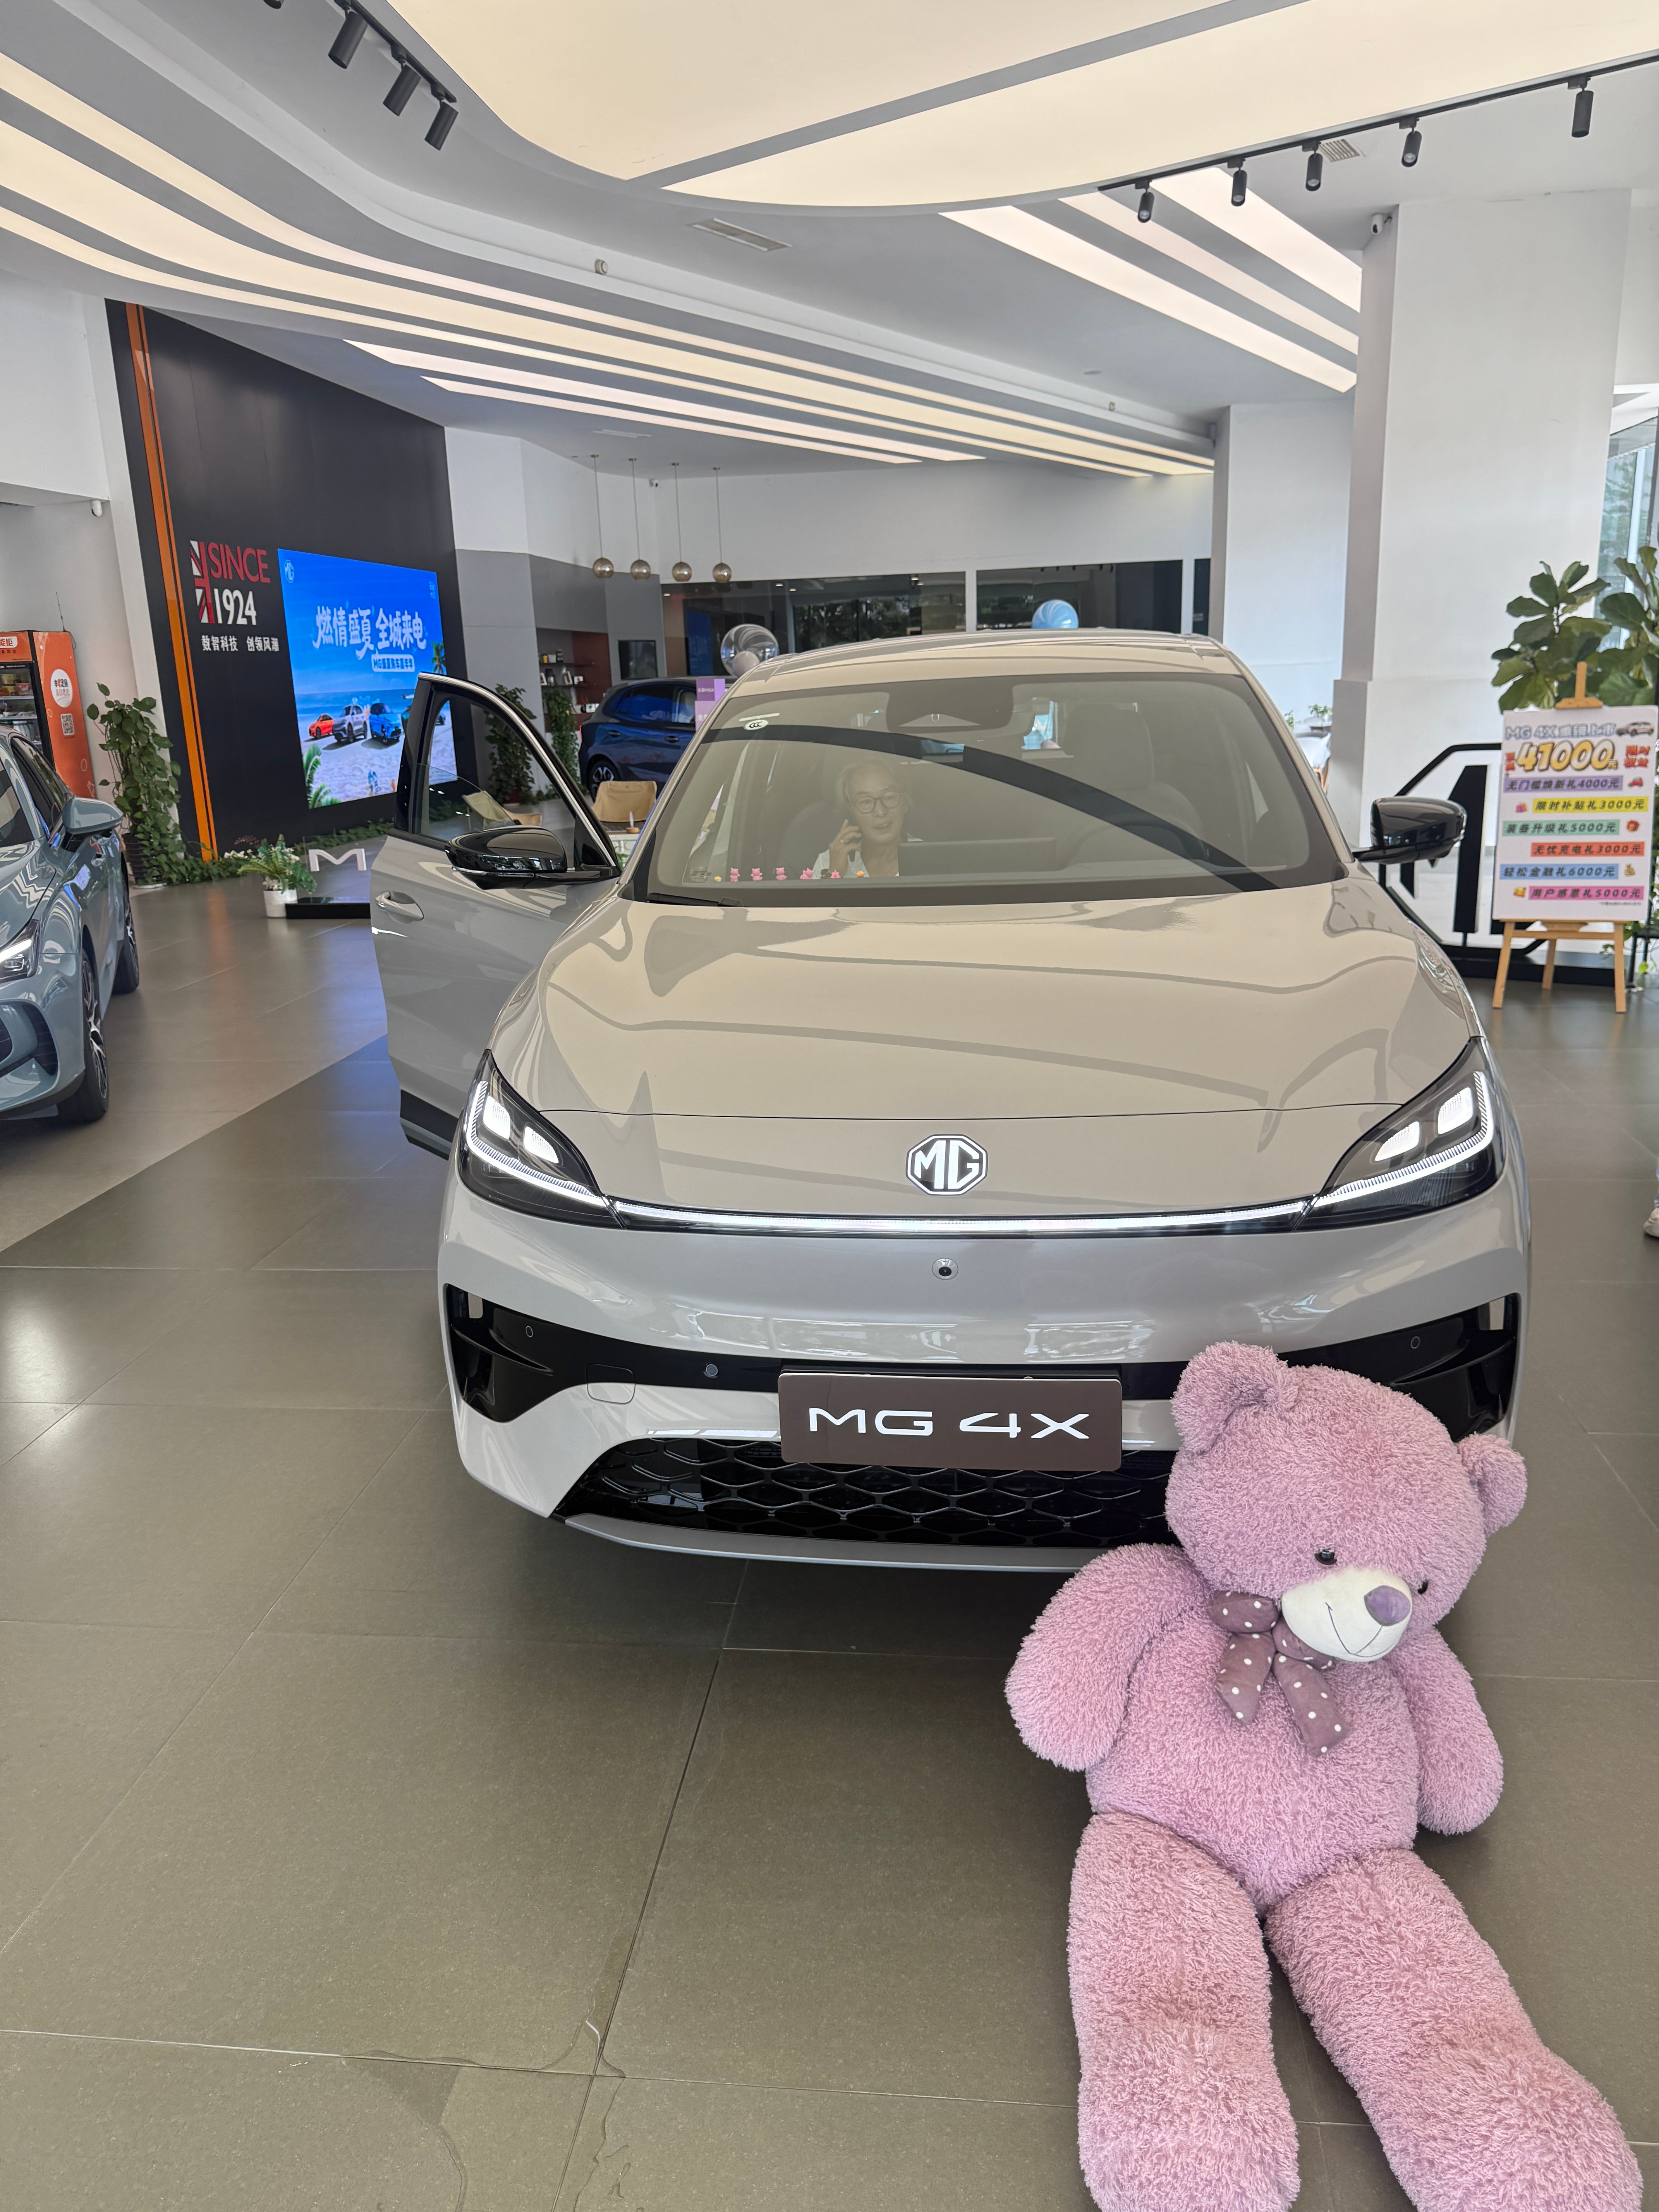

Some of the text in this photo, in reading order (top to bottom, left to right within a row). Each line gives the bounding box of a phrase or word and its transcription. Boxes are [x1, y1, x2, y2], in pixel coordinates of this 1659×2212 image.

[208, 542, 270, 583] SINCE
[214, 588, 256, 625] 1924
[201, 635, 239, 651] 数智科技
[313, 605, 426, 660] 燃情盛夏 全城来电
[1505, 725, 1532, 740] MG
[1533, 724, 1557, 738] 4X
[915, 1140, 980, 1190] MG
[809, 1408, 1089, 1439] MG 4X
